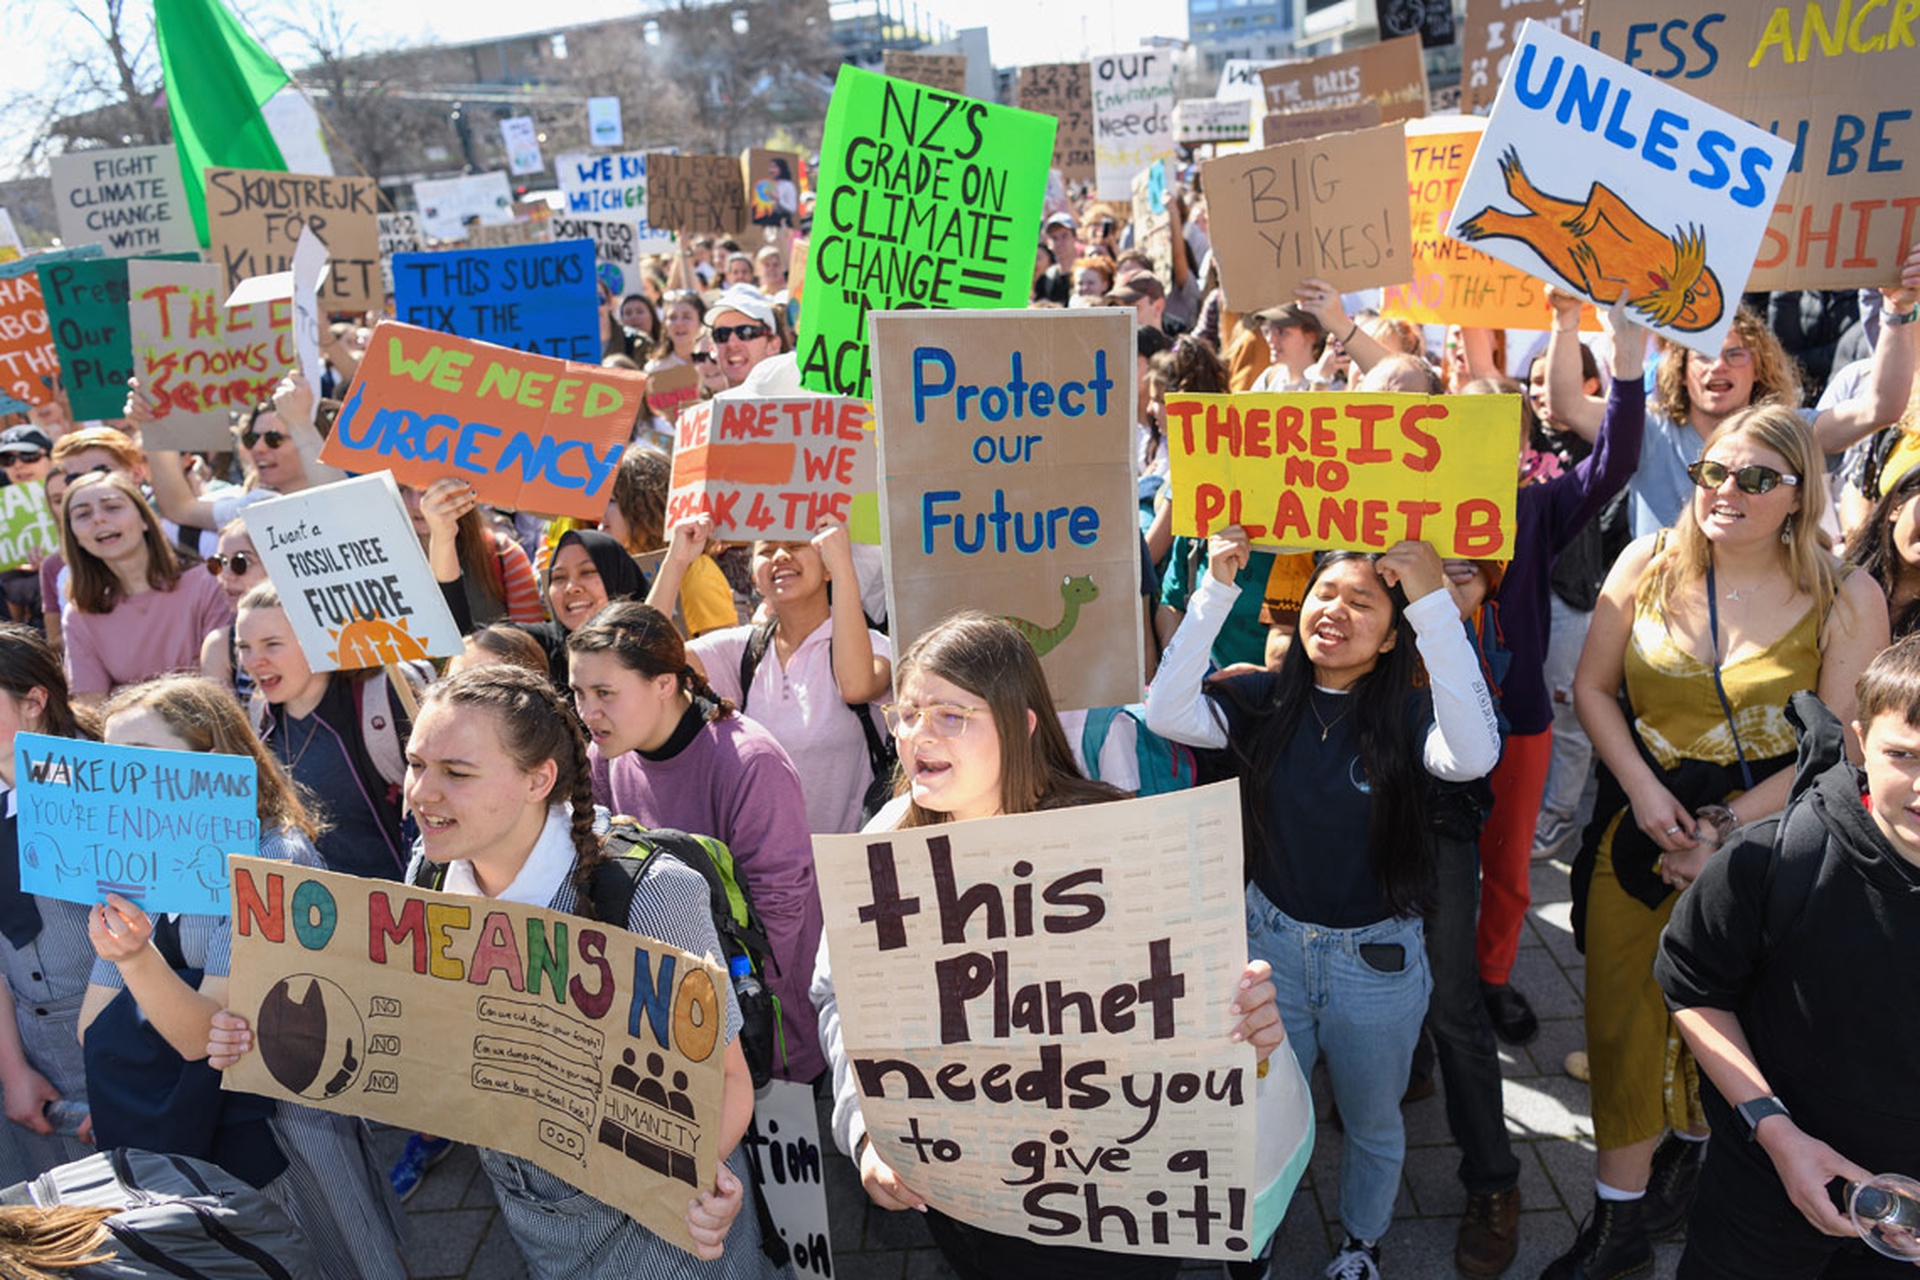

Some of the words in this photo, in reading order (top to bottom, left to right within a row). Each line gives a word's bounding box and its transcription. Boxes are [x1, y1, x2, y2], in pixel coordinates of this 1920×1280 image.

[879, 81, 988, 160] NZ'S
[1514, 43, 1774, 208] UNLESS
[1827, 109, 1913, 176] BE
[94, 155, 158, 182] FIGHT
[577, 156, 612, 183] WE
[844, 136, 953, 201] GRADE
[961, 163, 1008, 213] ON
[1412, 143, 1463, 172] THE
[69, 178, 168, 208] CLIMATE
[211, 171, 374, 216] SKOLSTREJK
[1242, 152, 1341, 224] BIG
[86, 202, 172, 231] CHANGE
[108, 227, 160, 249] WITH
[829, 184, 1013, 264] CLIMATE
[1258, 208, 1395, 270] YIKES!
[404, 257, 490, 297] THIS
[502, 254, 583, 291] SUCKS
[58, 318, 116, 351] Our
[408, 305, 458, 335] FIX
[470, 302, 523, 336] THE
[388, 337, 475, 394] WE
[476, 362, 624, 418] NEED
[911, 346, 1114, 424] Protect
[337, 381, 625, 498] URGENCY
[680, 407, 710, 448] WE
[719, 403, 779, 441] ARE
[781, 398, 868, 442] THE
[1166, 401, 1340, 458] THERE
[1344, 404, 1450, 473] IS
[803, 445, 857, 485] WE
[972, 434, 1043, 464] our
[1284, 455, 1350, 492] NO
[266, 525, 279, 550] I
[279, 520, 308, 544] want
[311, 524, 322, 537] a
[745, 491, 776, 532] 4
[778, 491, 852, 532] THE
[920, 488, 1100, 555] Future
[1195, 483, 1442, 547] PLANET
[1453, 498, 1505, 557] B
[286, 548, 343, 579] FOSSIL
[337, 537, 388, 570] FREE
[303, 575, 414, 628] FUTURE
[22, 749, 105, 795] WAKE
[110, 761, 147, 795] UP
[151, 765, 251, 801] HUMANS
[30, 794, 98, 831] YOU'RE
[107, 804, 257, 844] ENDANGERED
[85, 844, 158, 890] TOO!
[858, 835, 1107, 951] this
[235, 868, 337, 951] NO
[368, 890, 616, 1020] MEANS
[628, 946, 720, 1063] NO
[375, 1000, 397, 1014] NO
[935, 937, 1185, 1045] Planet
[375, 1039, 397, 1051] NO
[373, 1075, 396, 1091] NO!
[852, 1044, 1112, 1110] needs
[1116, 1067, 1246, 1145] you
[603, 1094, 702, 1153] HUMANITY
[899, 1117, 963, 1164] to
[1001, 1129, 1132, 1186] give
[1167, 1149, 1209, 1180] a
